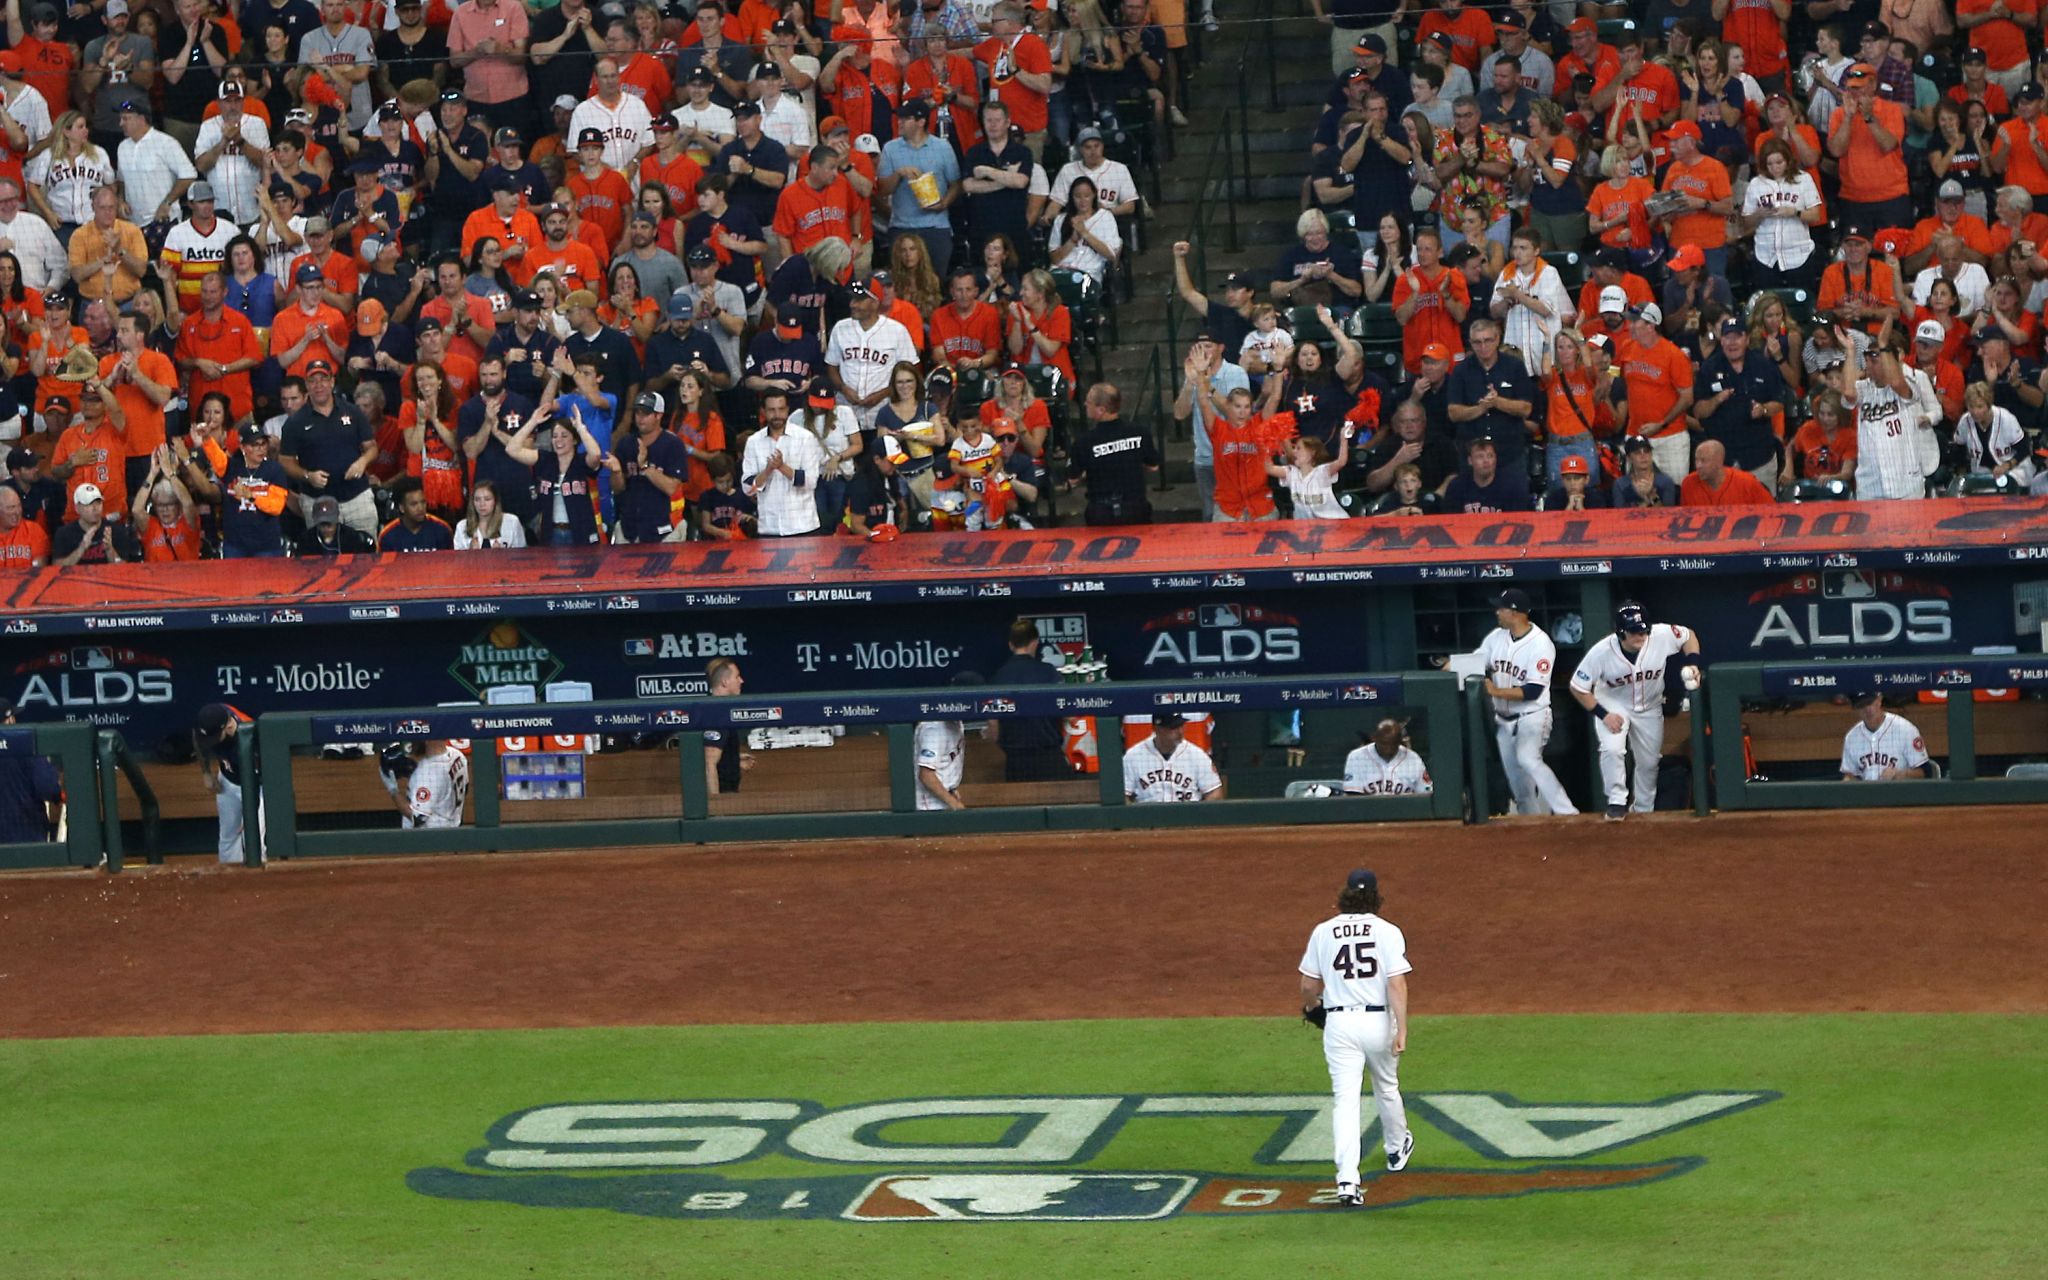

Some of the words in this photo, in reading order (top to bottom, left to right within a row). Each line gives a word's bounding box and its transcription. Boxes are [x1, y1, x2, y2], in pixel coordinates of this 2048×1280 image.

[187, 247, 225, 261] Astro
[1885, 418, 1902, 437] 30
[1092, 436, 1143, 458] SECURITY
[1824, 557, 1858, 567] ALDS
[1306, 573, 1325, 583] MLB
[1325, 570, 1373, 582] NETWORK
[1480, 568, 1514, 578] ALDS
[1072, 581, 1085, 592] At
[1086, 580, 1105, 591] Bat
[1212, 577, 1246, 588] ALDS
[807, 590, 830, 601] PLAY
[831, 589, 872, 602] BALL.org
[978, 586, 1011, 597] ALDS
[606, 600, 640, 610] ALDS
[98, 619, 117, 628] MLB
[117, 616, 164, 628] NETWORK
[271, 613, 303, 624] ALDS
[1750, 600, 1952, 647] ALDS
[5, 623, 37, 635] ALDS
[659, 633, 693, 658] At
[696, 633, 749, 656] Bat
[1040, 636, 1084, 644] TWORK
[1144, 627, 1300, 666] ALDS
[461, 645, 550, 665] Minute
[475, 663, 539, 685] Maid
[1491, 660, 1528, 682] STROS
[2023, 669, 2043, 680] MLB
[1803, 676, 1816, 687] At
[1817, 675, 1837, 686] Bat
[1938, 674, 1972, 684] ALDS
[17, 669, 173, 708] ALDS
[1175, 693, 1198, 704] PLAY
[1199, 692, 1241, 704] BALL.org
[1343, 690, 1378, 700] ALDS
[982, 703, 1016, 713] ALDS
[485, 719, 505, 729] MLB
[505, 717, 553, 728] NETWORK
[656, 715, 690, 725] ALDS
[396, 724, 431, 734] ALDS
[1138, 769, 1193, 791] ASTROS
[1333, 924, 1372, 939] COLE
[1332, 942, 1379, 980] 45
[476, 1096, 1768, 1168] ALDS
